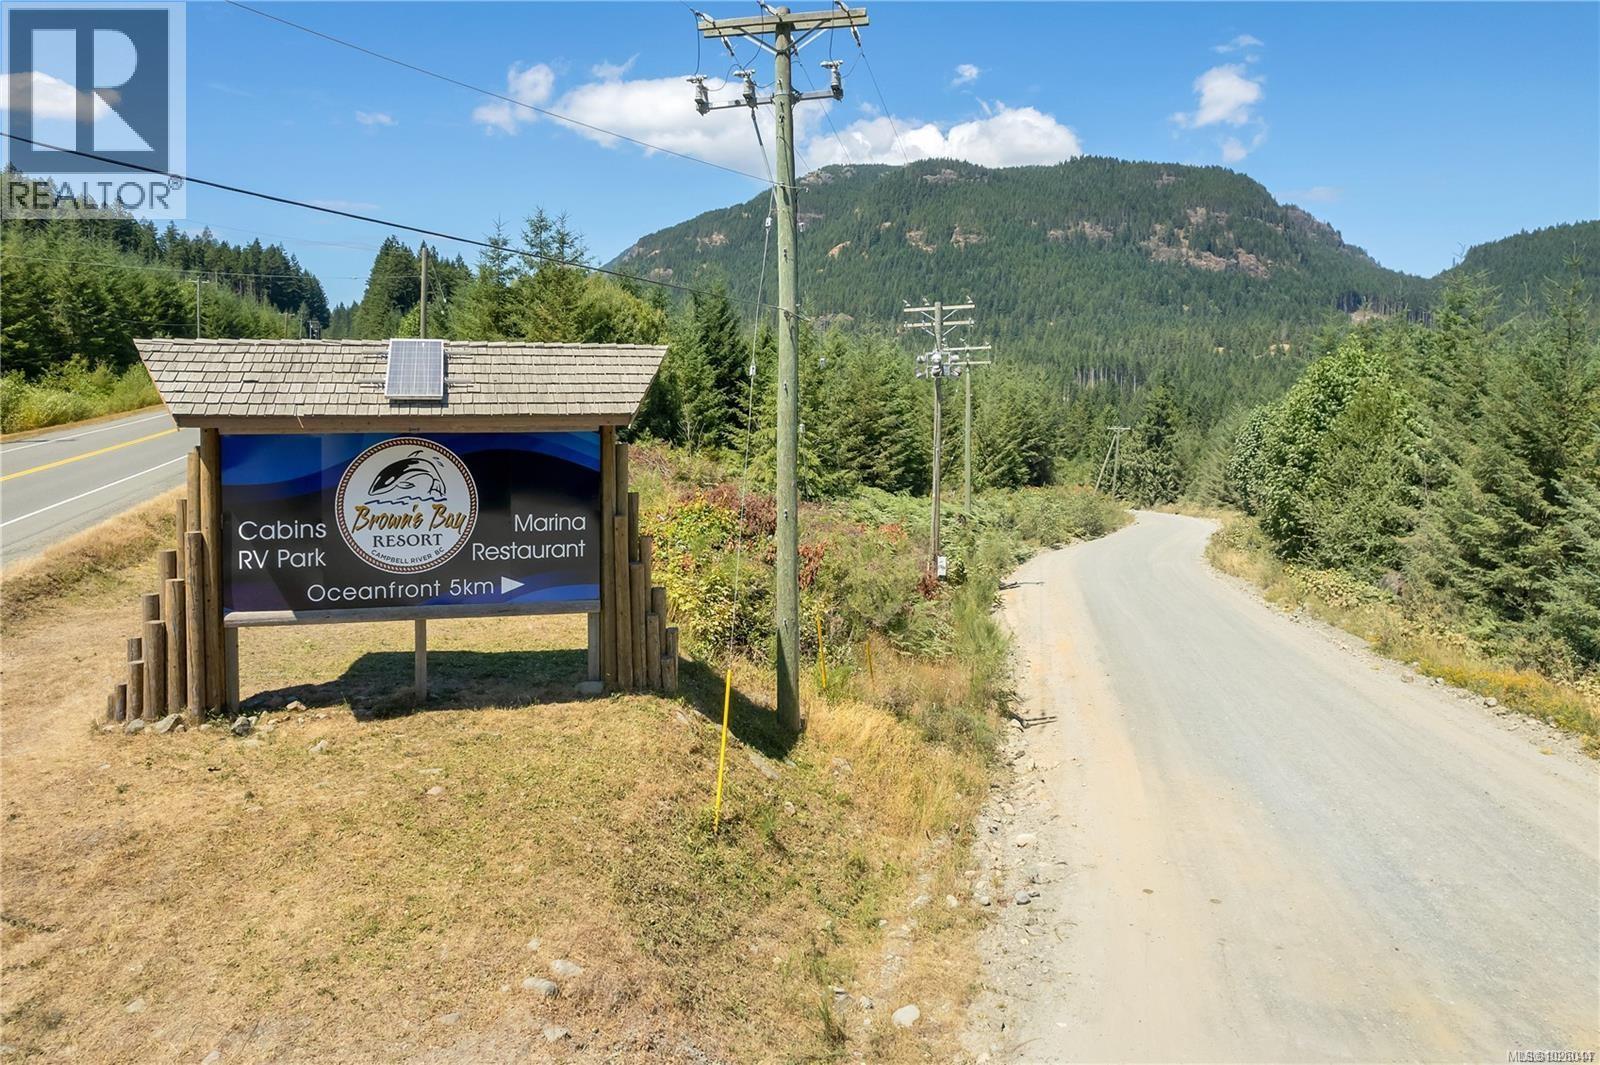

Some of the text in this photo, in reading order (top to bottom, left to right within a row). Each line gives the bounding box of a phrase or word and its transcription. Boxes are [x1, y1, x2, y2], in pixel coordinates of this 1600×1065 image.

[351, 503, 467, 535] Brown's Bay
[514, 513, 586, 532] Marina
[238, 520, 327, 541] Cabins
[373, 533, 443, 548] RESORT
[239, 548, 327, 570] RV Park
[371, 546, 445, 564] CAMPBELL RIVER BC
[472, 539, 586, 561] Restaurant
[307, 578, 494, 602] Oceanfront 5km
